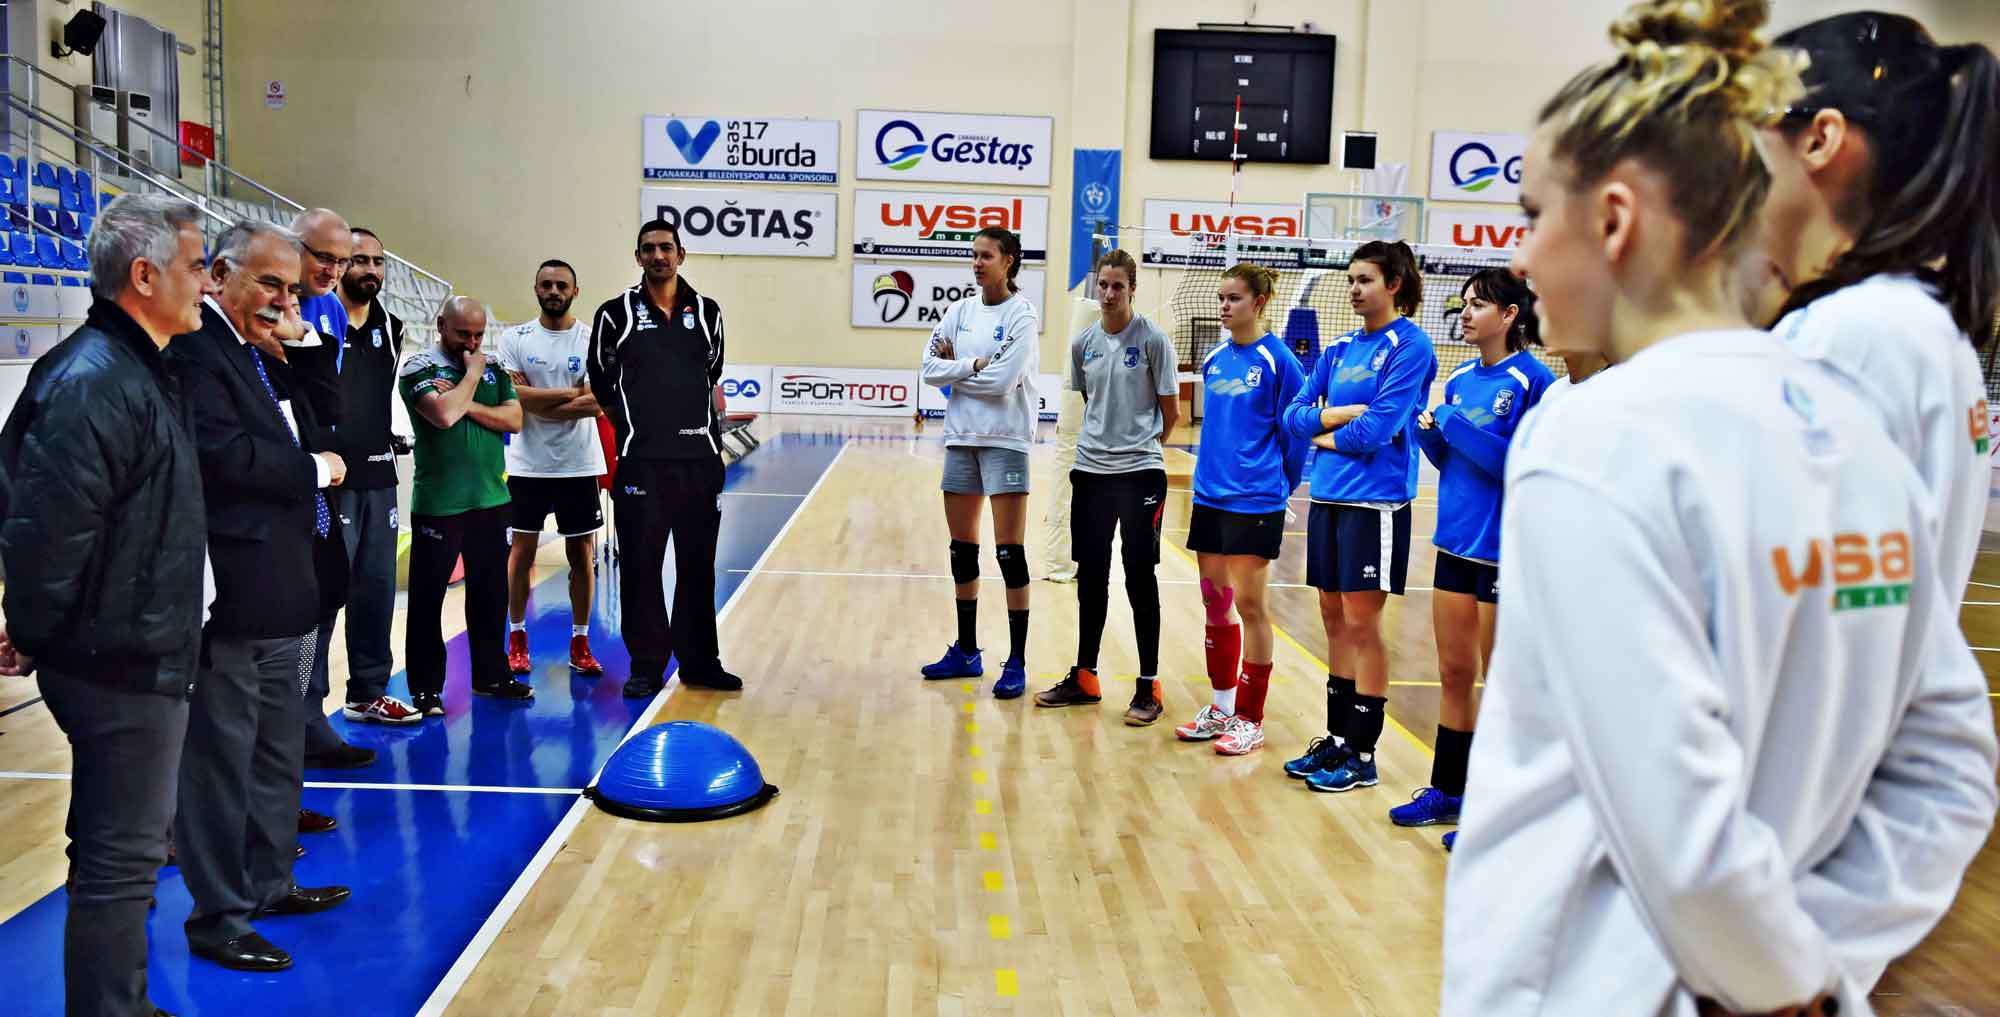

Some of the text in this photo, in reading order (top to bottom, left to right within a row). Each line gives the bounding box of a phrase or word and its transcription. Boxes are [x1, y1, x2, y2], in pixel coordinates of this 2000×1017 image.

[727, 120, 740, 166] esas
[742, 121, 769, 140] 17
[741, 142, 817, 168] burda
[931, 133, 1034, 171] Gestaş
[657, 170, 704, 179] ÇANAKKALE
[768, 173, 786, 181] ANA
[789, 174, 833, 182] SPONSORU
[881, 198, 1022, 238] uysal
